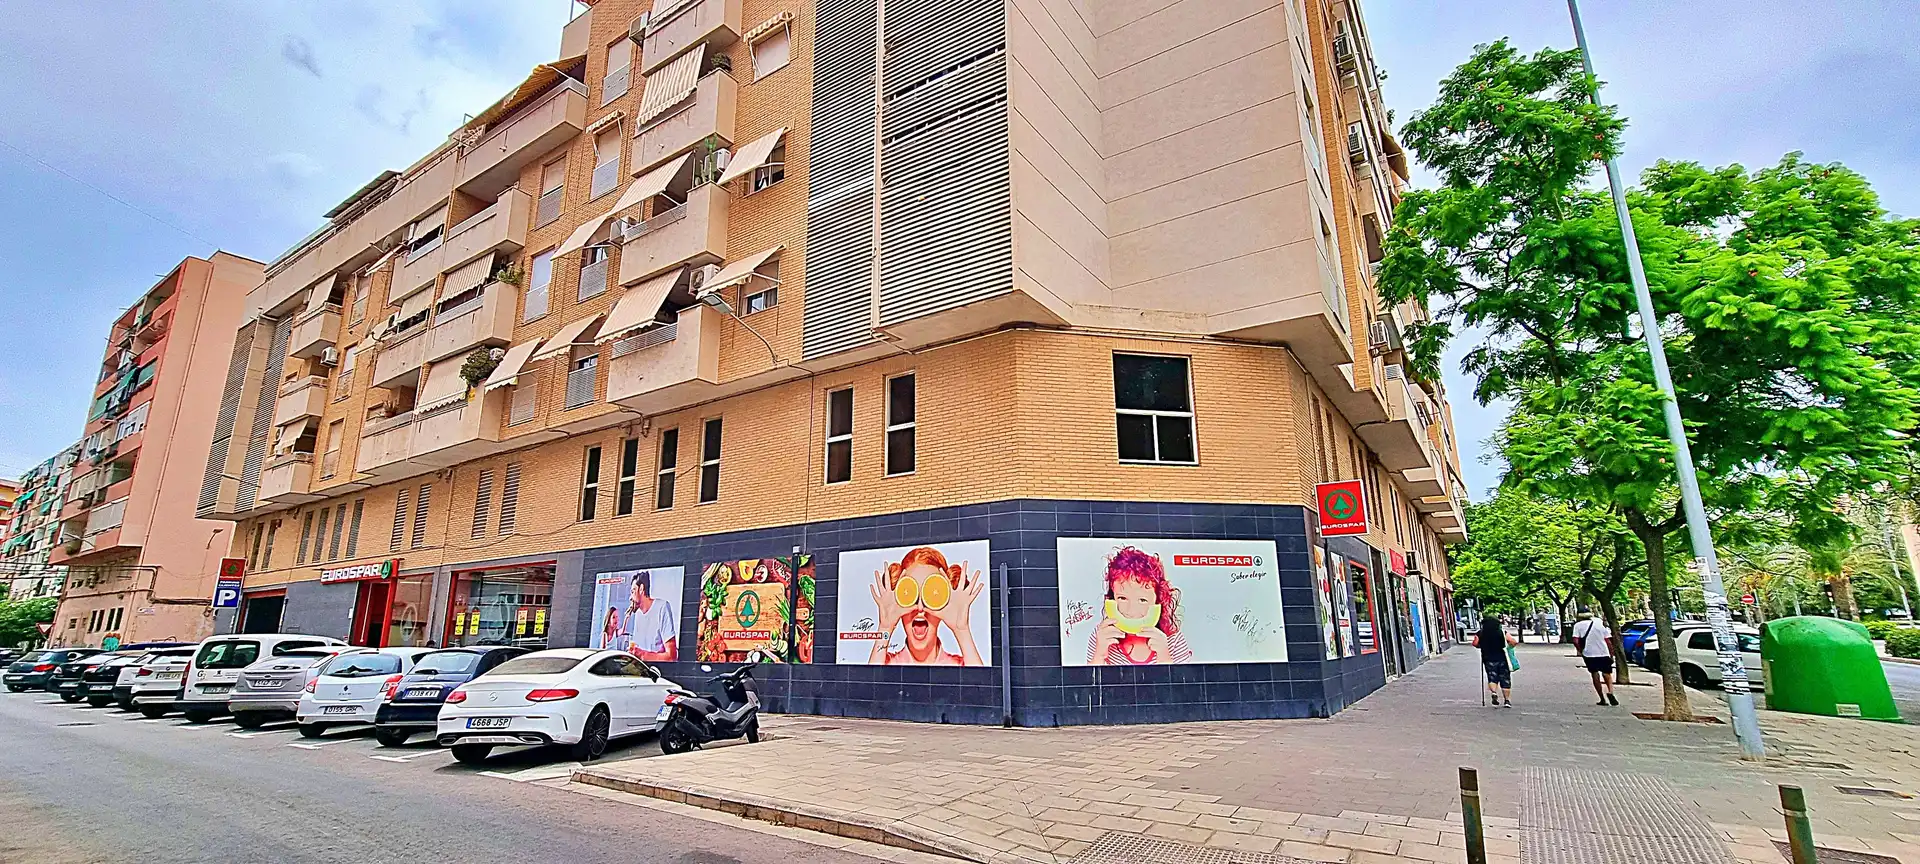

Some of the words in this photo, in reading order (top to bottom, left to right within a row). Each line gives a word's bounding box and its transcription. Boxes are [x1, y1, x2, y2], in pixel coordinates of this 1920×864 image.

[321, 564, 382, 582] EUROSPAR
[217, 589, 236, 605] P
[724, 631, 770, 639] EUROSPAR
[471, 718, 492, 726] 4668
[493, 718, 509, 726] JSP
